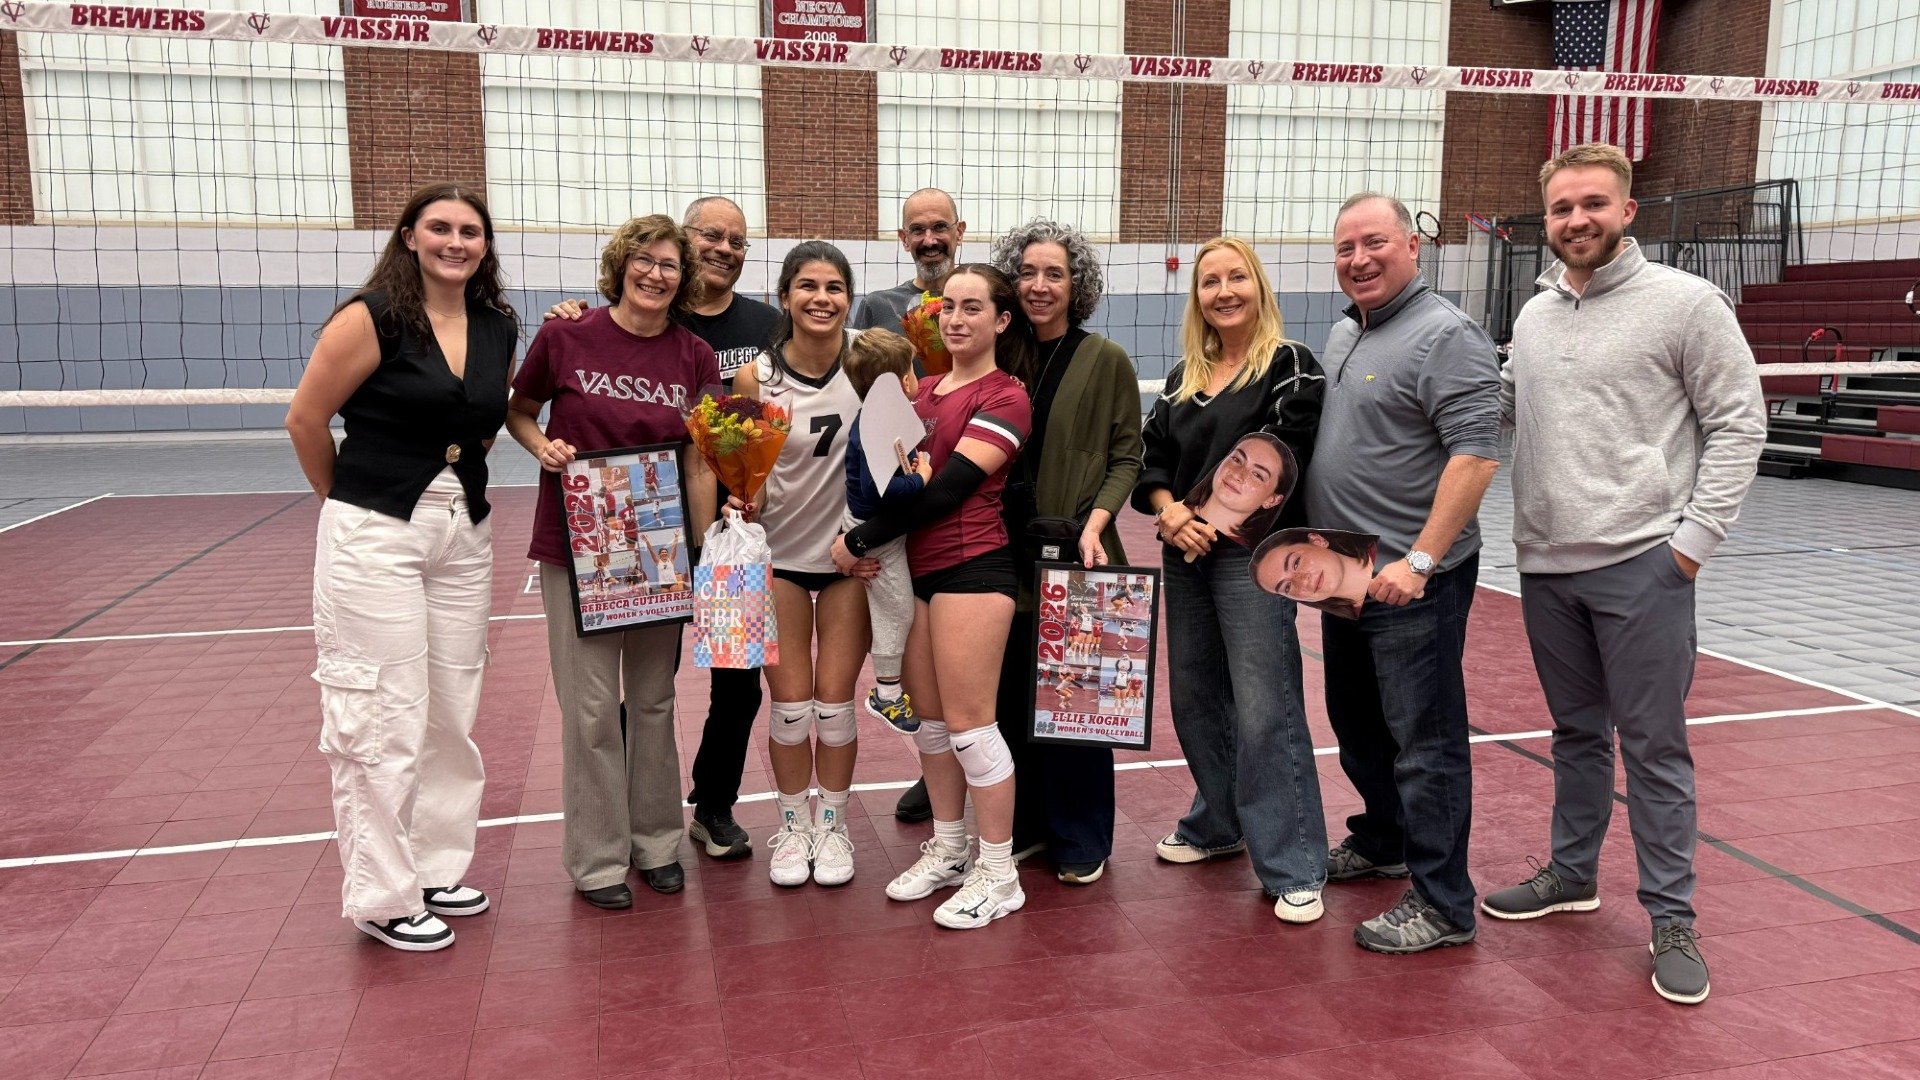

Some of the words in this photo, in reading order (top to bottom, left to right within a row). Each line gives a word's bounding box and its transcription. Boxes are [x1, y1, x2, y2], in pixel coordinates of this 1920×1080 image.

[366, 0, 448, 12] RUNNERS-UP
[795, 1, 845, 14] NECVA
[778, 12, 862, 28] CHAMPIONS
[804, 31, 838, 42] 2008
[70, 3, 206, 31] BREWERS
[321, 16, 430, 42] VASSAR
[536, 27, 655, 53] BREWERS
[753, 38, 849, 63] VASSAR
[940, 48, 1042, 71] BREWERS
[1129, 56, 1212, 78] VASSAR
[1291, 62, 1384, 83] BREWERS
[1460, 68, 1534, 87] VASSAR
[1604, 73, 1687, 92] BREWERS
[1754, 78, 1820, 97] VASSAR
[575, 369, 688, 408] VASSAR
[809, 413, 843, 458] 7
[562, 474, 599, 553] 2026
[700, 580, 741, 600] CE
[581, 600, 630, 614] REBECCA
[632, 591, 693, 607] GUTIERREZ
[583, 612, 605, 628] #7
[700, 608, 744, 628] EBR
[1038, 581, 1067, 662] 2026
[700, 634, 742, 655] ATE
[1035, 721, 1056, 734] #2
[1051, 712, 1085, 724] ELLIE
[1088, 714, 1129, 727] KOGAN
